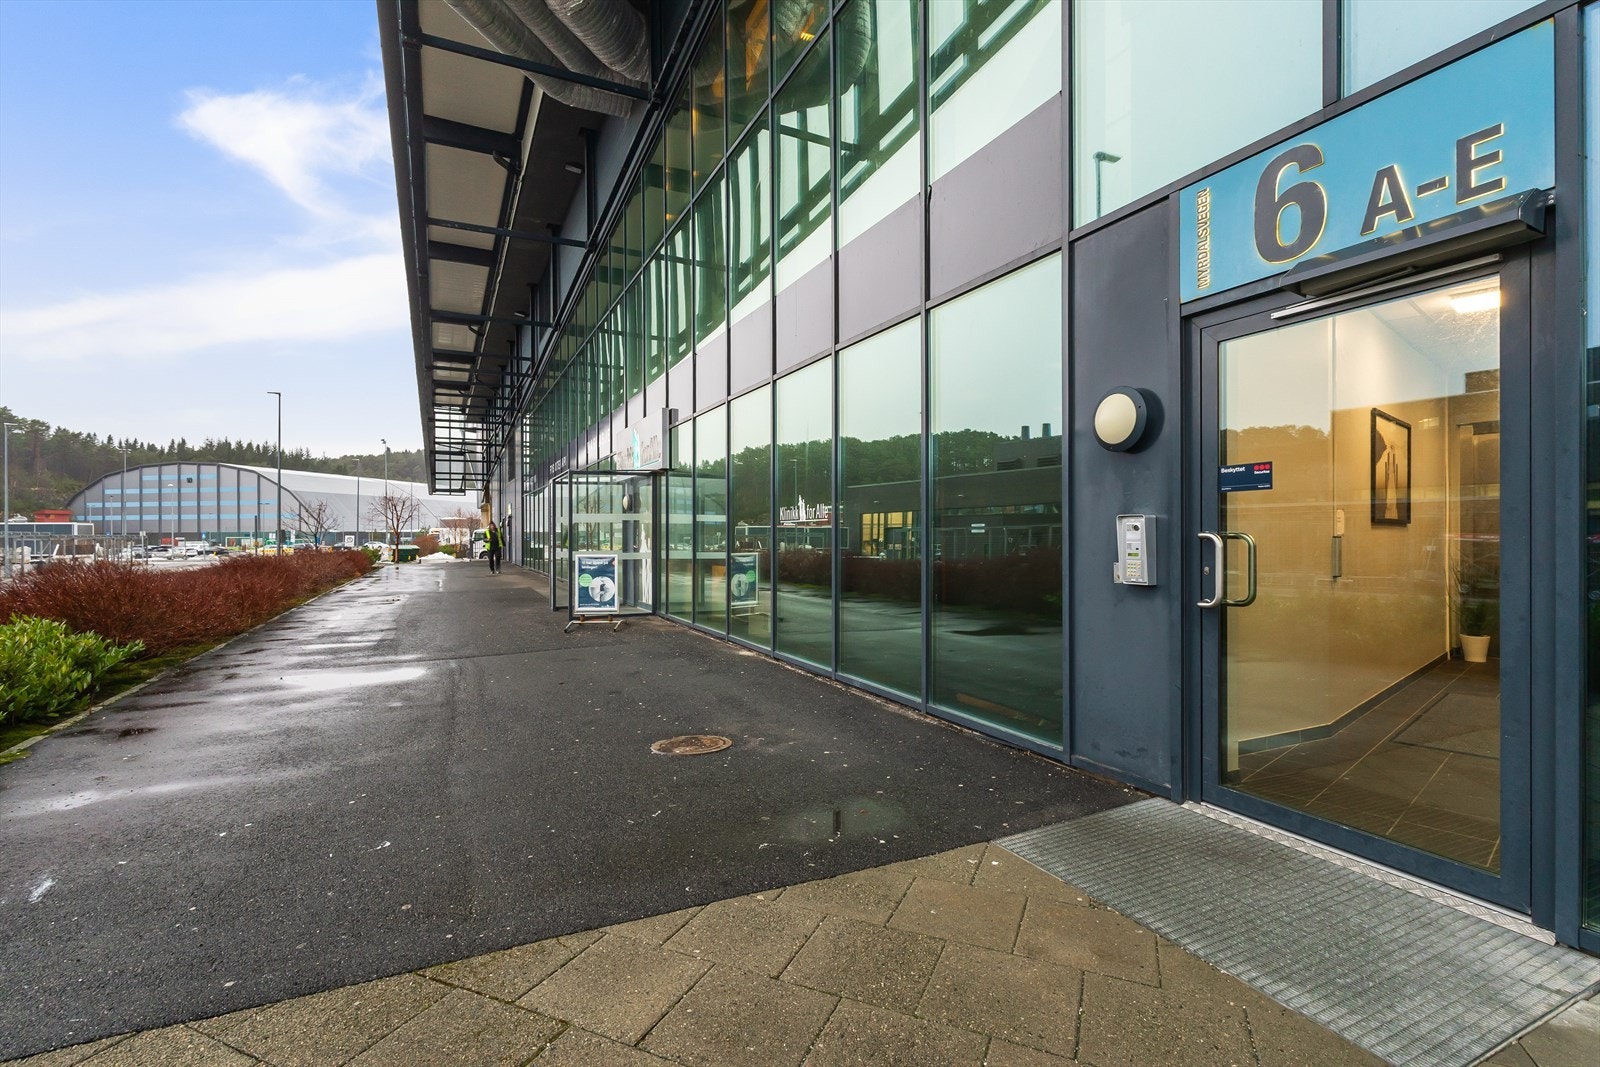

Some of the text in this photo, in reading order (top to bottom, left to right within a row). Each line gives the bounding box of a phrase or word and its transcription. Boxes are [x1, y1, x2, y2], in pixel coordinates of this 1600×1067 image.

[1197, 187, 1210, 289] MYRDALSVEGEN
[1254, 143, 1327, 264] 6
[779, 504, 829, 520] Klinikk for Alle
